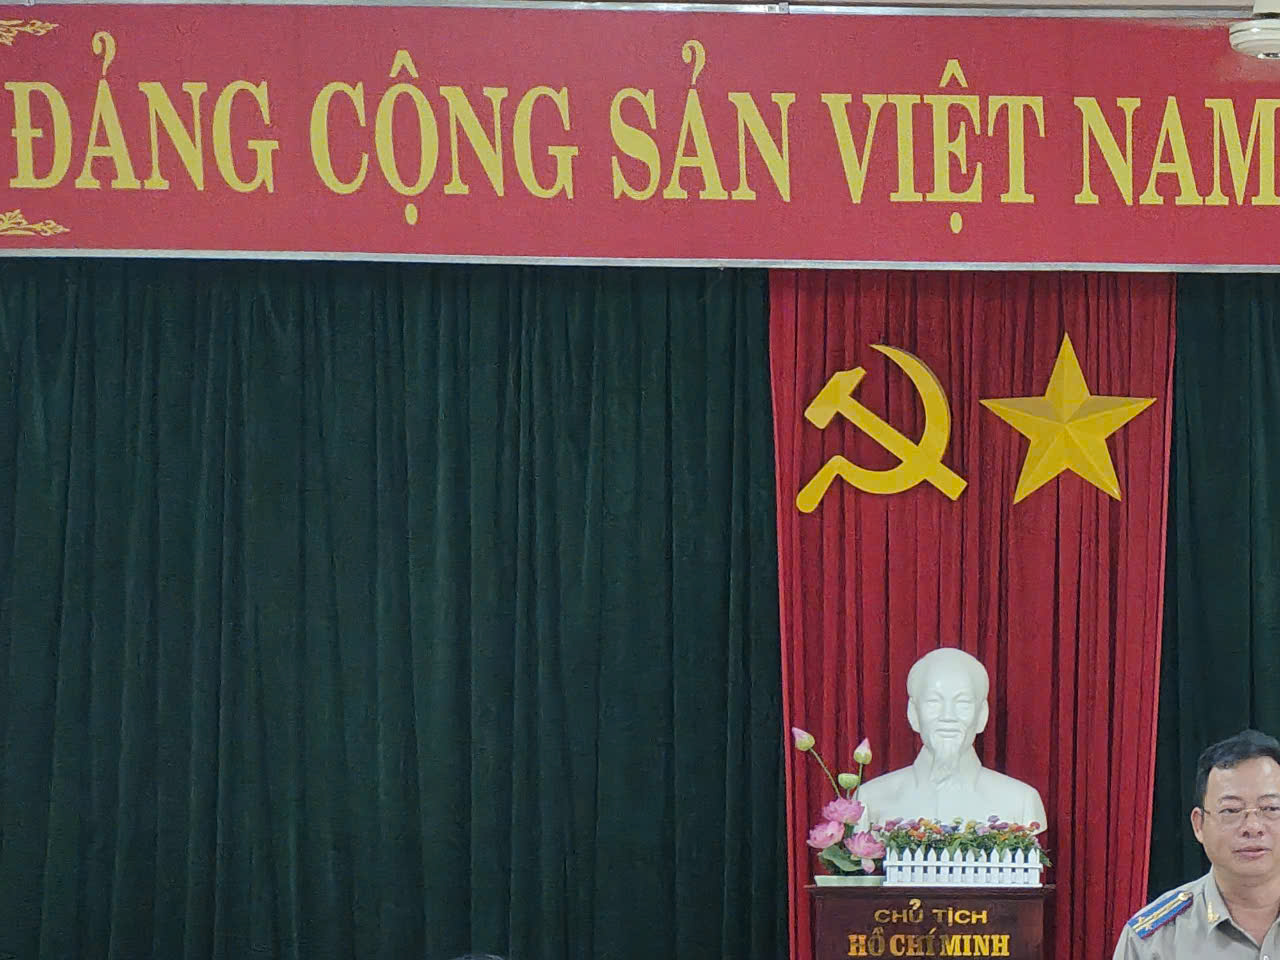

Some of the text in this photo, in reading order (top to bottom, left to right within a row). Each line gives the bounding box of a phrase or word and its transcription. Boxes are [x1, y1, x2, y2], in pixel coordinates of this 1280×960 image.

[4, 31, 279, 194] ĐẢNG
[310, 50, 578, 225] CỘNG
[610, 40, 796, 202] SẢN
[821, 59, 1045, 234] VIỆT
[874, 898, 988, 927] CHỦ TỊCH
[848, 926, 1010, 957] HỒ CHÍ MINH
